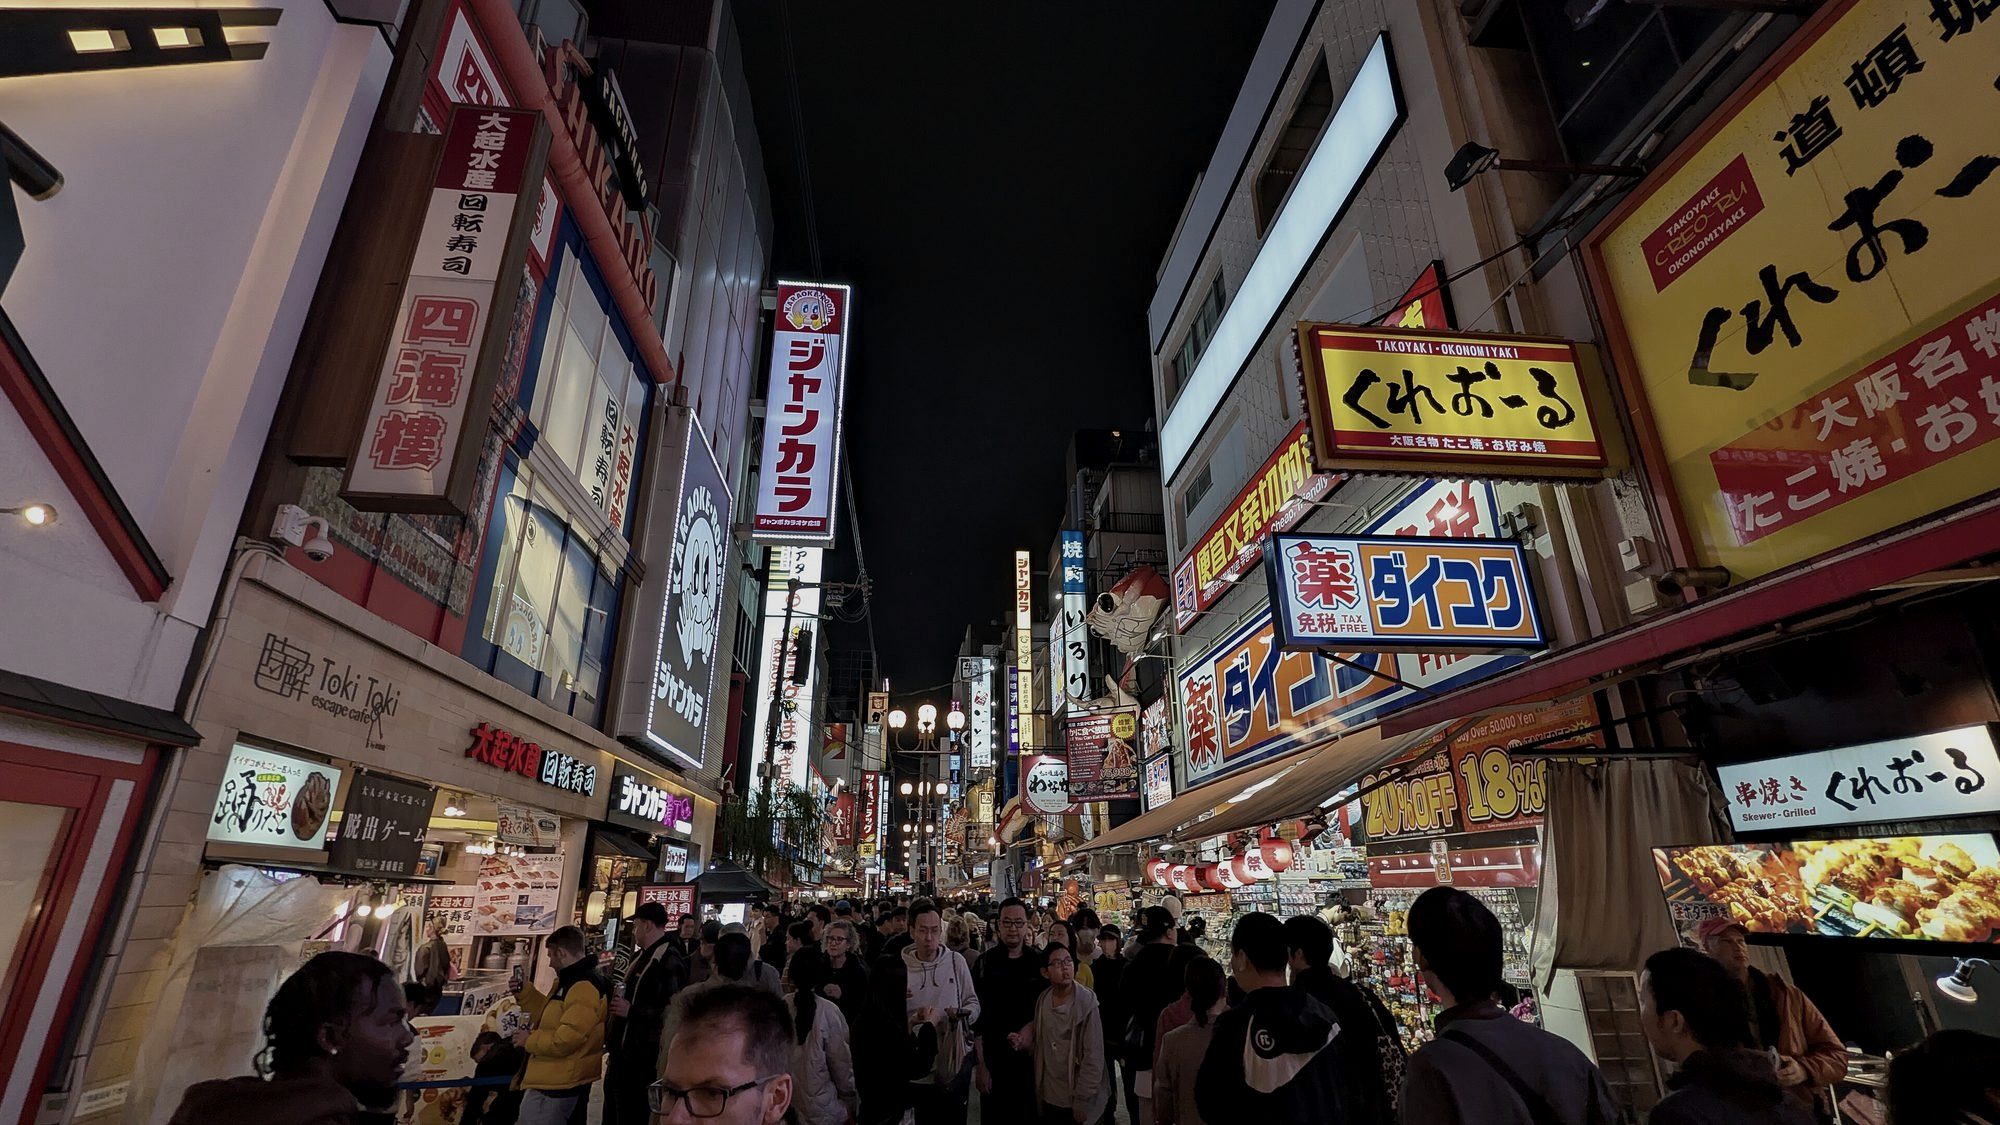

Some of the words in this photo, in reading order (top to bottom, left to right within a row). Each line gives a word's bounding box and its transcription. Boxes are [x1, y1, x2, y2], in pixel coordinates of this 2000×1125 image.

[462, 113, 510, 190] 大起水産
[603, 76, 648, 198] PACHINKO
[442, 193, 488, 276] 回転寿司
[1666, 187, 1721, 237] TAKOYAKI
[1668, 206, 1746, 275] OKONOMIYAKI
[1689, 74, 2000, 391] くれおー
[1343, 361, 1575, 429] くれおーる
[774, 338, 825, 512] ジャンカラ
[1390, 435, 1439, 448] 大阪名物
[1197, 433, 1313, 590] 便宜又亲切的
[1394, 480, 1486, 537] 税
[1018, 557, 1030, 612] ジャンカラ
[1063, 541, 1084, 583] 焼肉
[1294, 541, 1358, 606] 薬
[1372, 552, 1524, 630] ダイコク
[1297, 611, 1338, 633] 免税
[1340, 624, 1369, 634] FREE
[1342, 614, 1363, 624] TAX
[1066, 609, 1086, 700] いろり
[311, 695, 349, 717] escape
[349, 708, 370, 724] cafe
[319, 657, 361, 702] Toki
[364, 676, 401, 717] Toki
[657, 660, 703, 728] ジャンカラ
[1471, 723, 1491, 740] Over
[1517, 711, 1535, 726] Yen
[467, 722, 541, 779] 大起水産
[542, 750, 597, 797] 回転寿司
[1825, 748, 1985, 811] くれおーる
[619, 775, 668, 823] ジャンカラ
[1735, 776, 1807, 808] 串焼き
[343, 813, 425, 843] 脱出ゲーム
[430, 896, 474, 908] 大起水産
[646, 890, 690, 901] 大起水産
